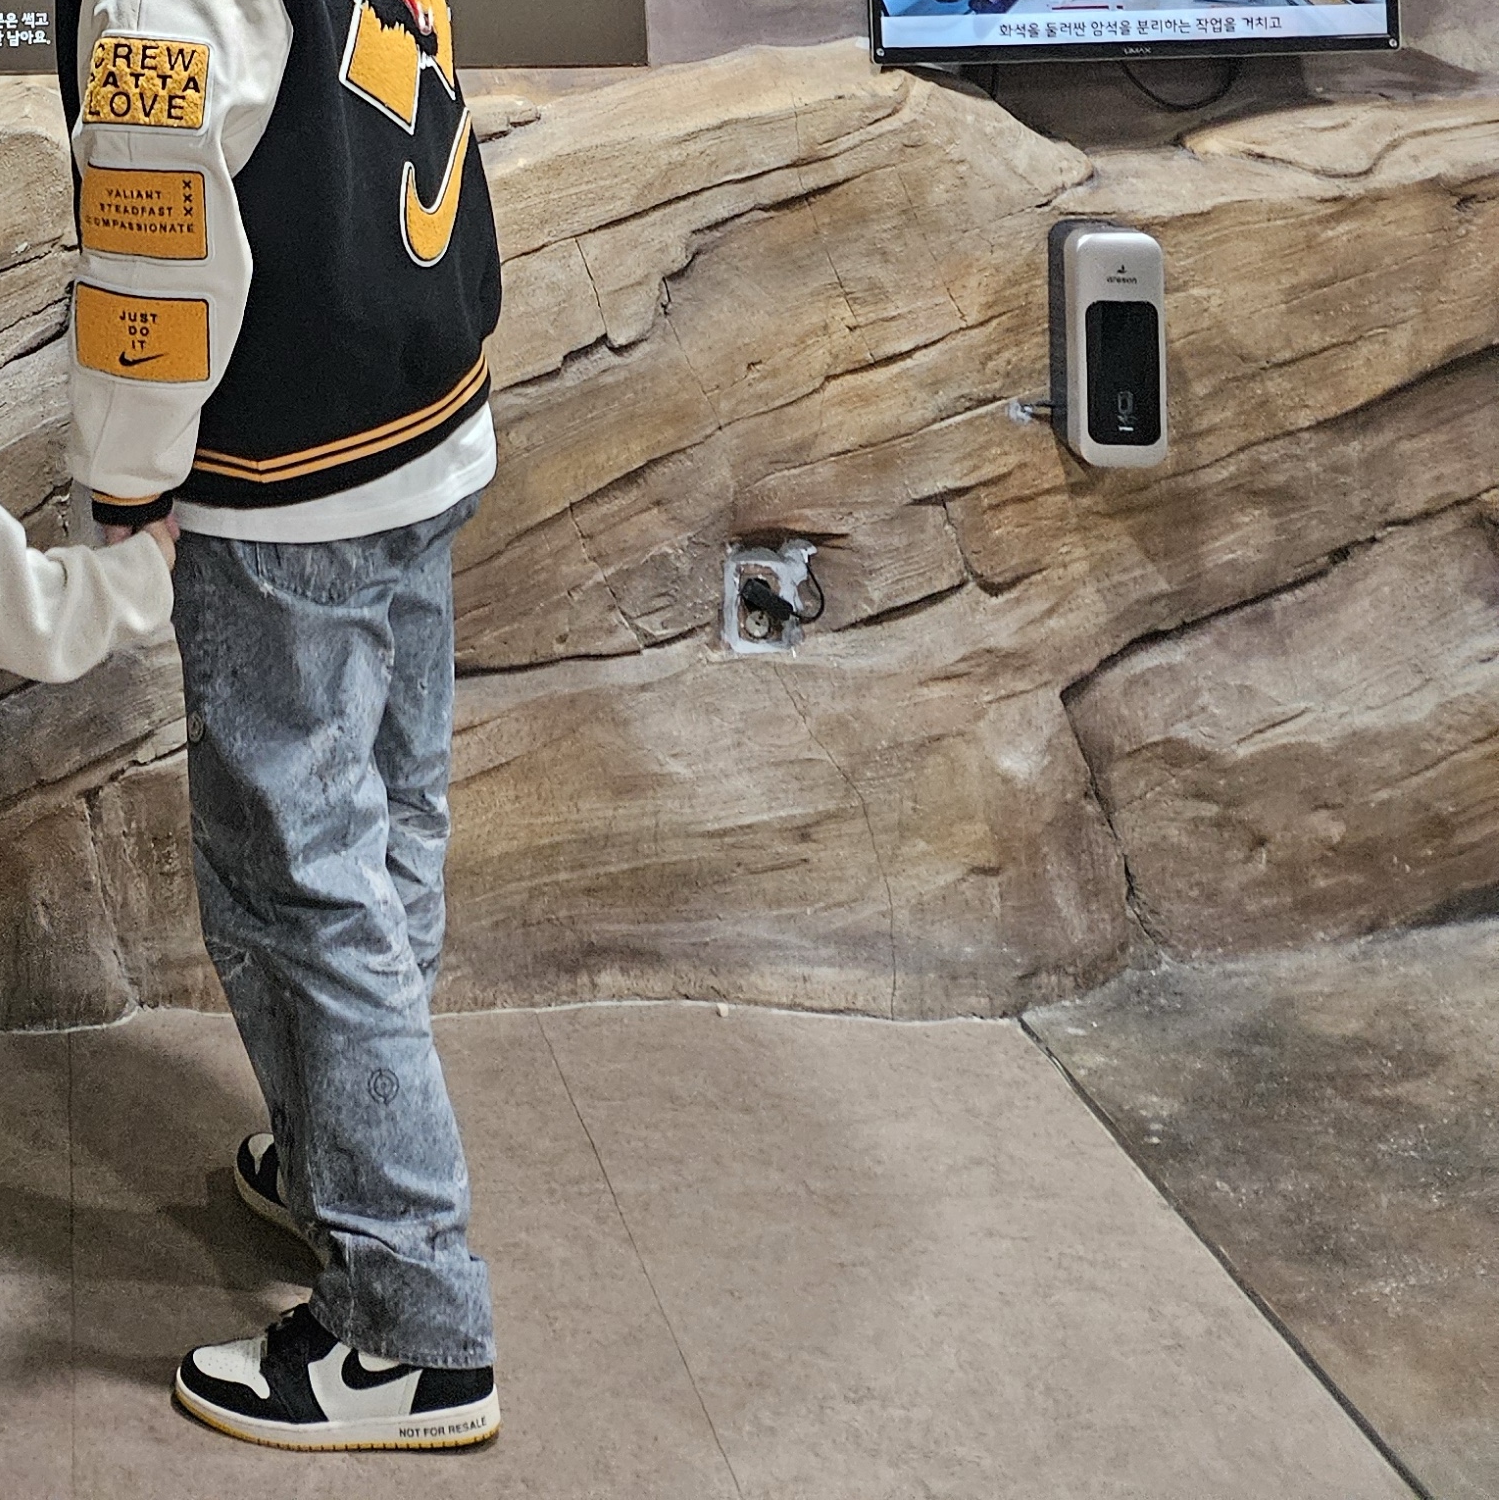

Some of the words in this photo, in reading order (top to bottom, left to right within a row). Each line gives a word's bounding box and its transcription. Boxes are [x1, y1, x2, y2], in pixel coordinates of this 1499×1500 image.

[21, 12, 49, 28] 썩고
[999, 22, 1040, 38] 화석을
[1045, 21, 1086, 38] 둘러싼
[1091, 20, 1132, 36] 암석을
[1137, 19, 1191, 35] 분리하는
[1196, 17, 1236, 33] 작업을
[1241, 16, 1282, 30] 거치고
[6, 30, 51, 47] 남아요.
[88, 90, 186, 121] LOVE
[105, 189, 162, 200] VALIANT
[99, 203, 173, 217] STEADFAST
[85, 215, 195, 234] COMPASSIONATE
[119, 310, 158, 324] JUST
[128, 325, 150, 337] DO
[131, 339, 146, 350] IT
[399, 1427, 421, 1438] NOT
[423, 1426, 445, 1437] FOR
[448, 1415, 487, 1434] RESALE
